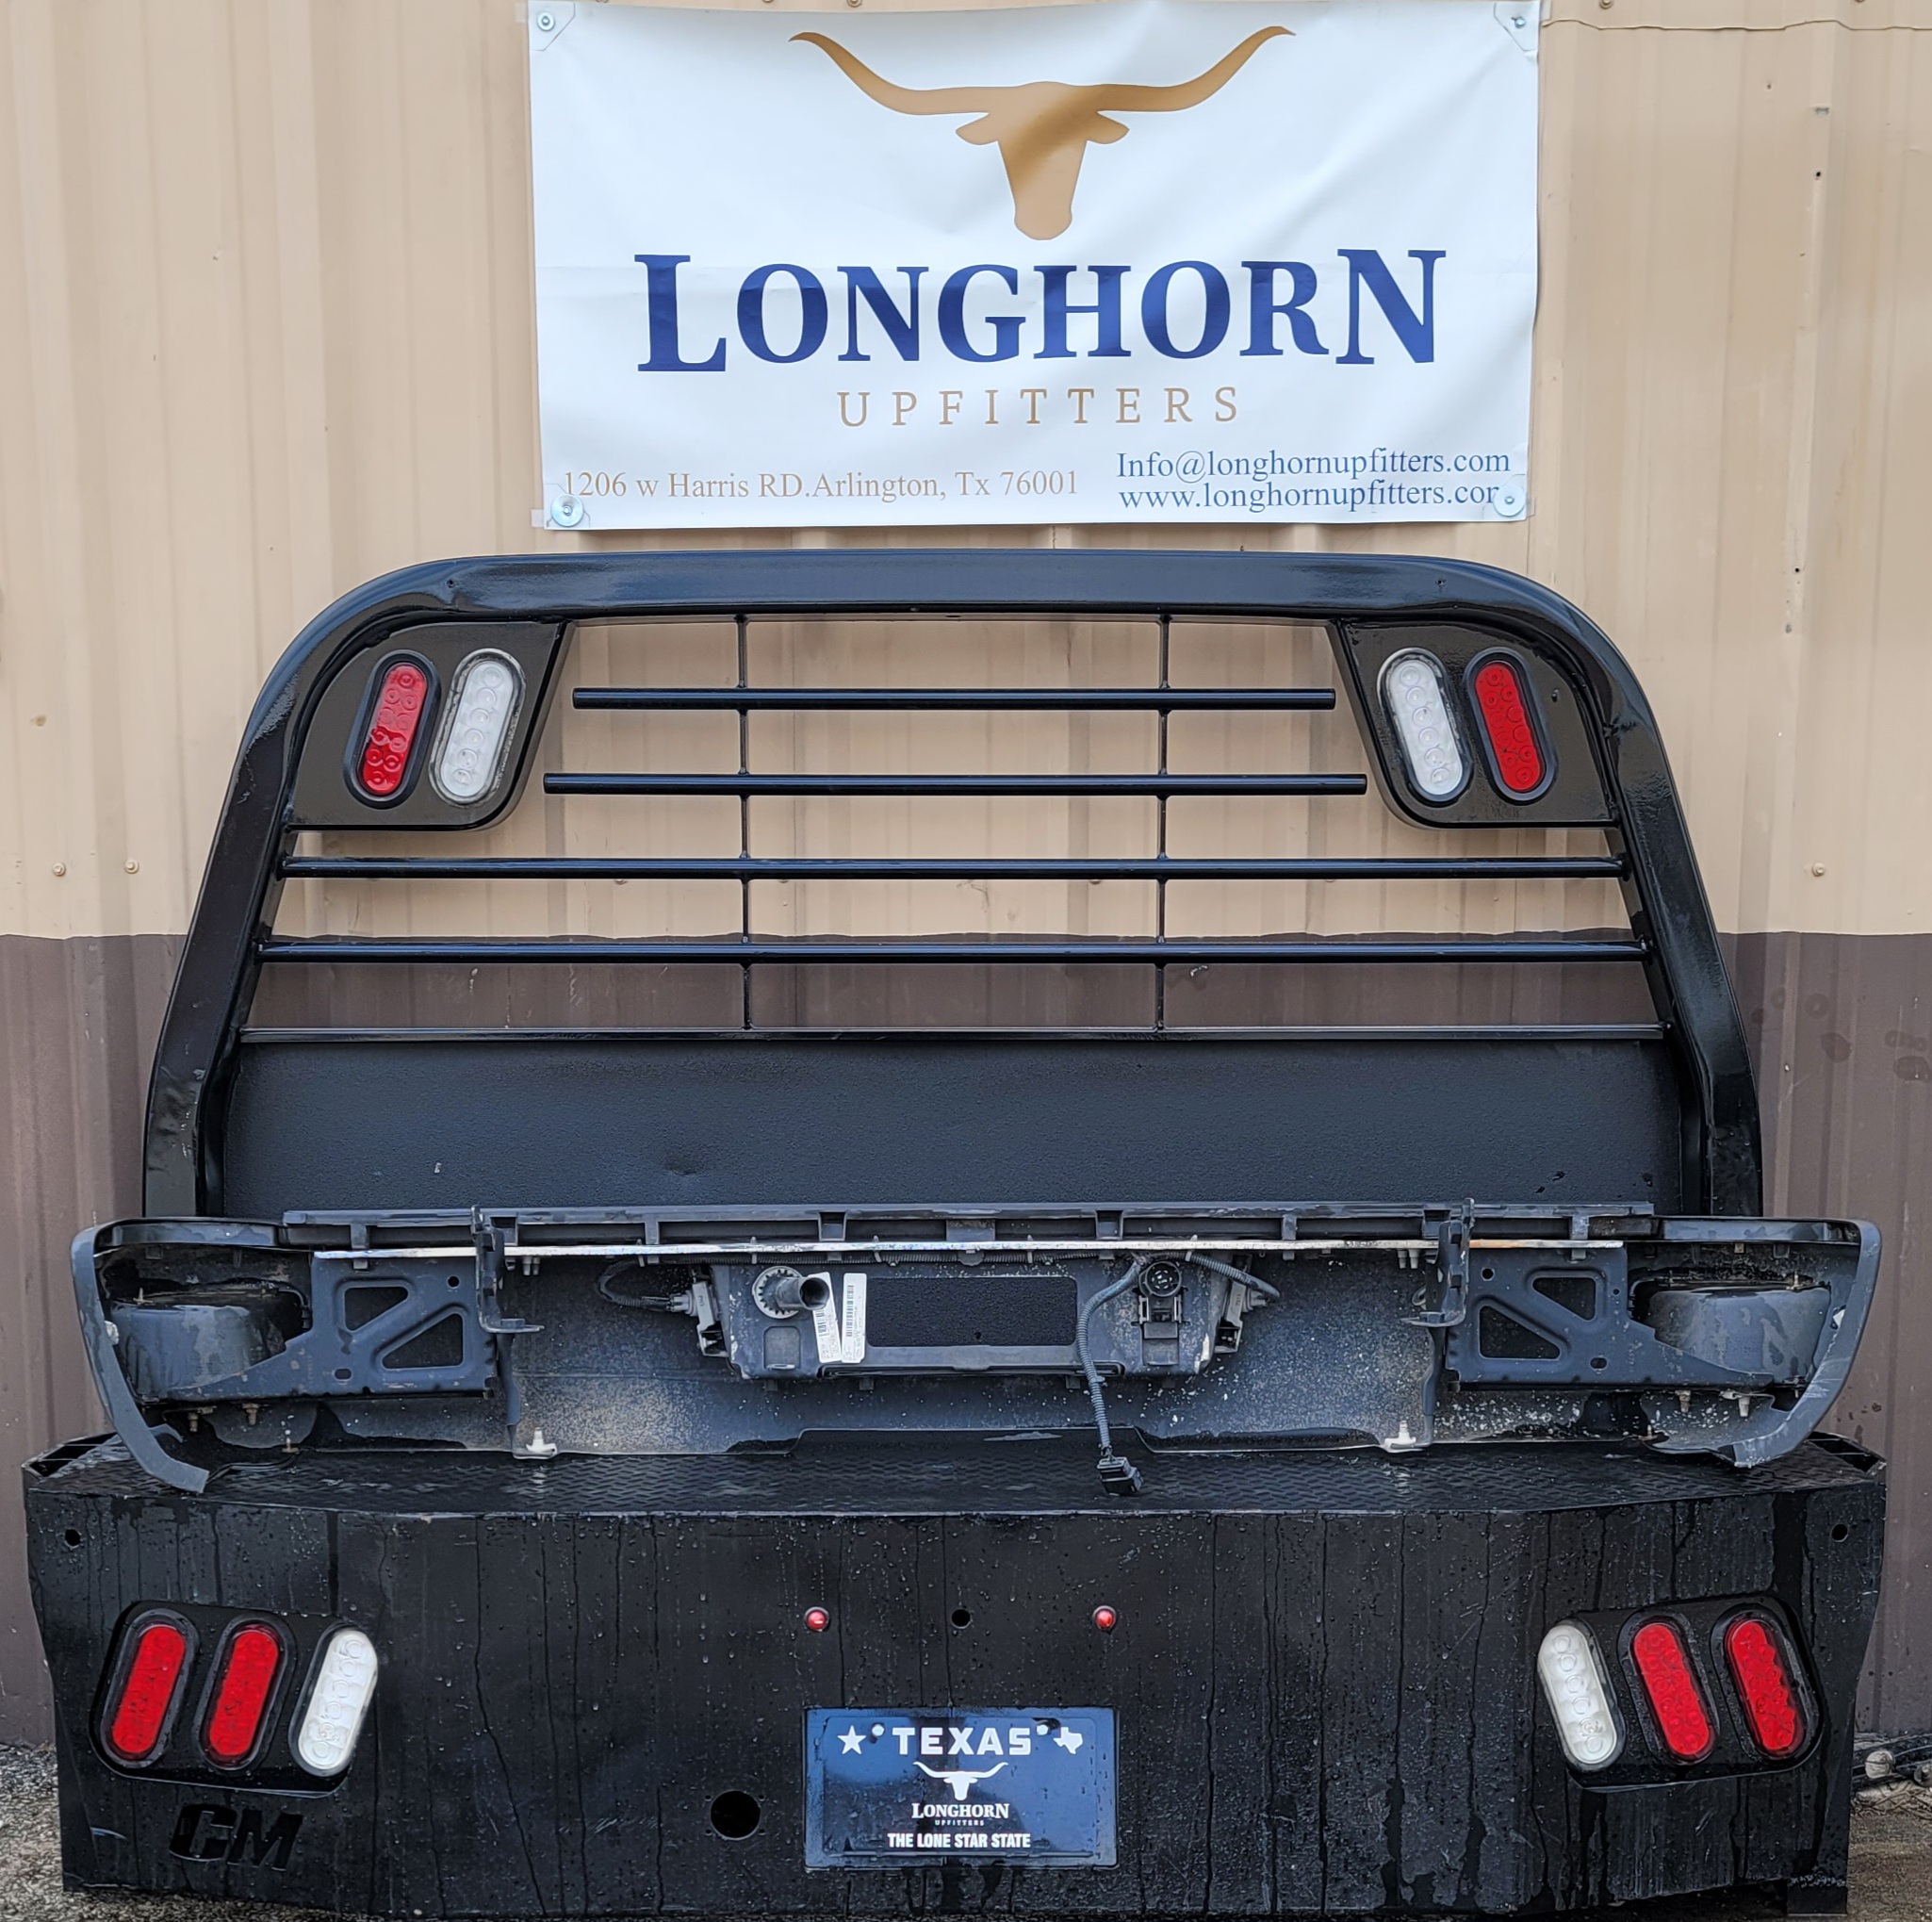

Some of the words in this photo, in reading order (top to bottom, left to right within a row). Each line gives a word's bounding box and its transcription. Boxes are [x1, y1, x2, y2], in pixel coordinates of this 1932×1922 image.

[634, 249, 1447, 371] LONGHORN
[837, 386, 1238, 427] UPFITTERS
[1117, 447, 1511, 484] Info@longhornupfitters.com
[565, 471, 628, 497] 1206
[635, 479, 660, 498] w
[667, 472, 750, 498] Harris
[758, 472, 947, 502] RD.Arlington,
[954, 471, 991, 496] Tx
[1000, 470, 1077, 495] 76001
[892, 1727, 1031, 1755] TEXAS
[911, 1803, 1009, 1819] LONGHORN
[887, 1833, 914, 1848] THE
[917, 1833, 951, 1848] LONE
[954, 1833, 987, 1848] STAR
[991, 1833, 1031, 1848] STATE
